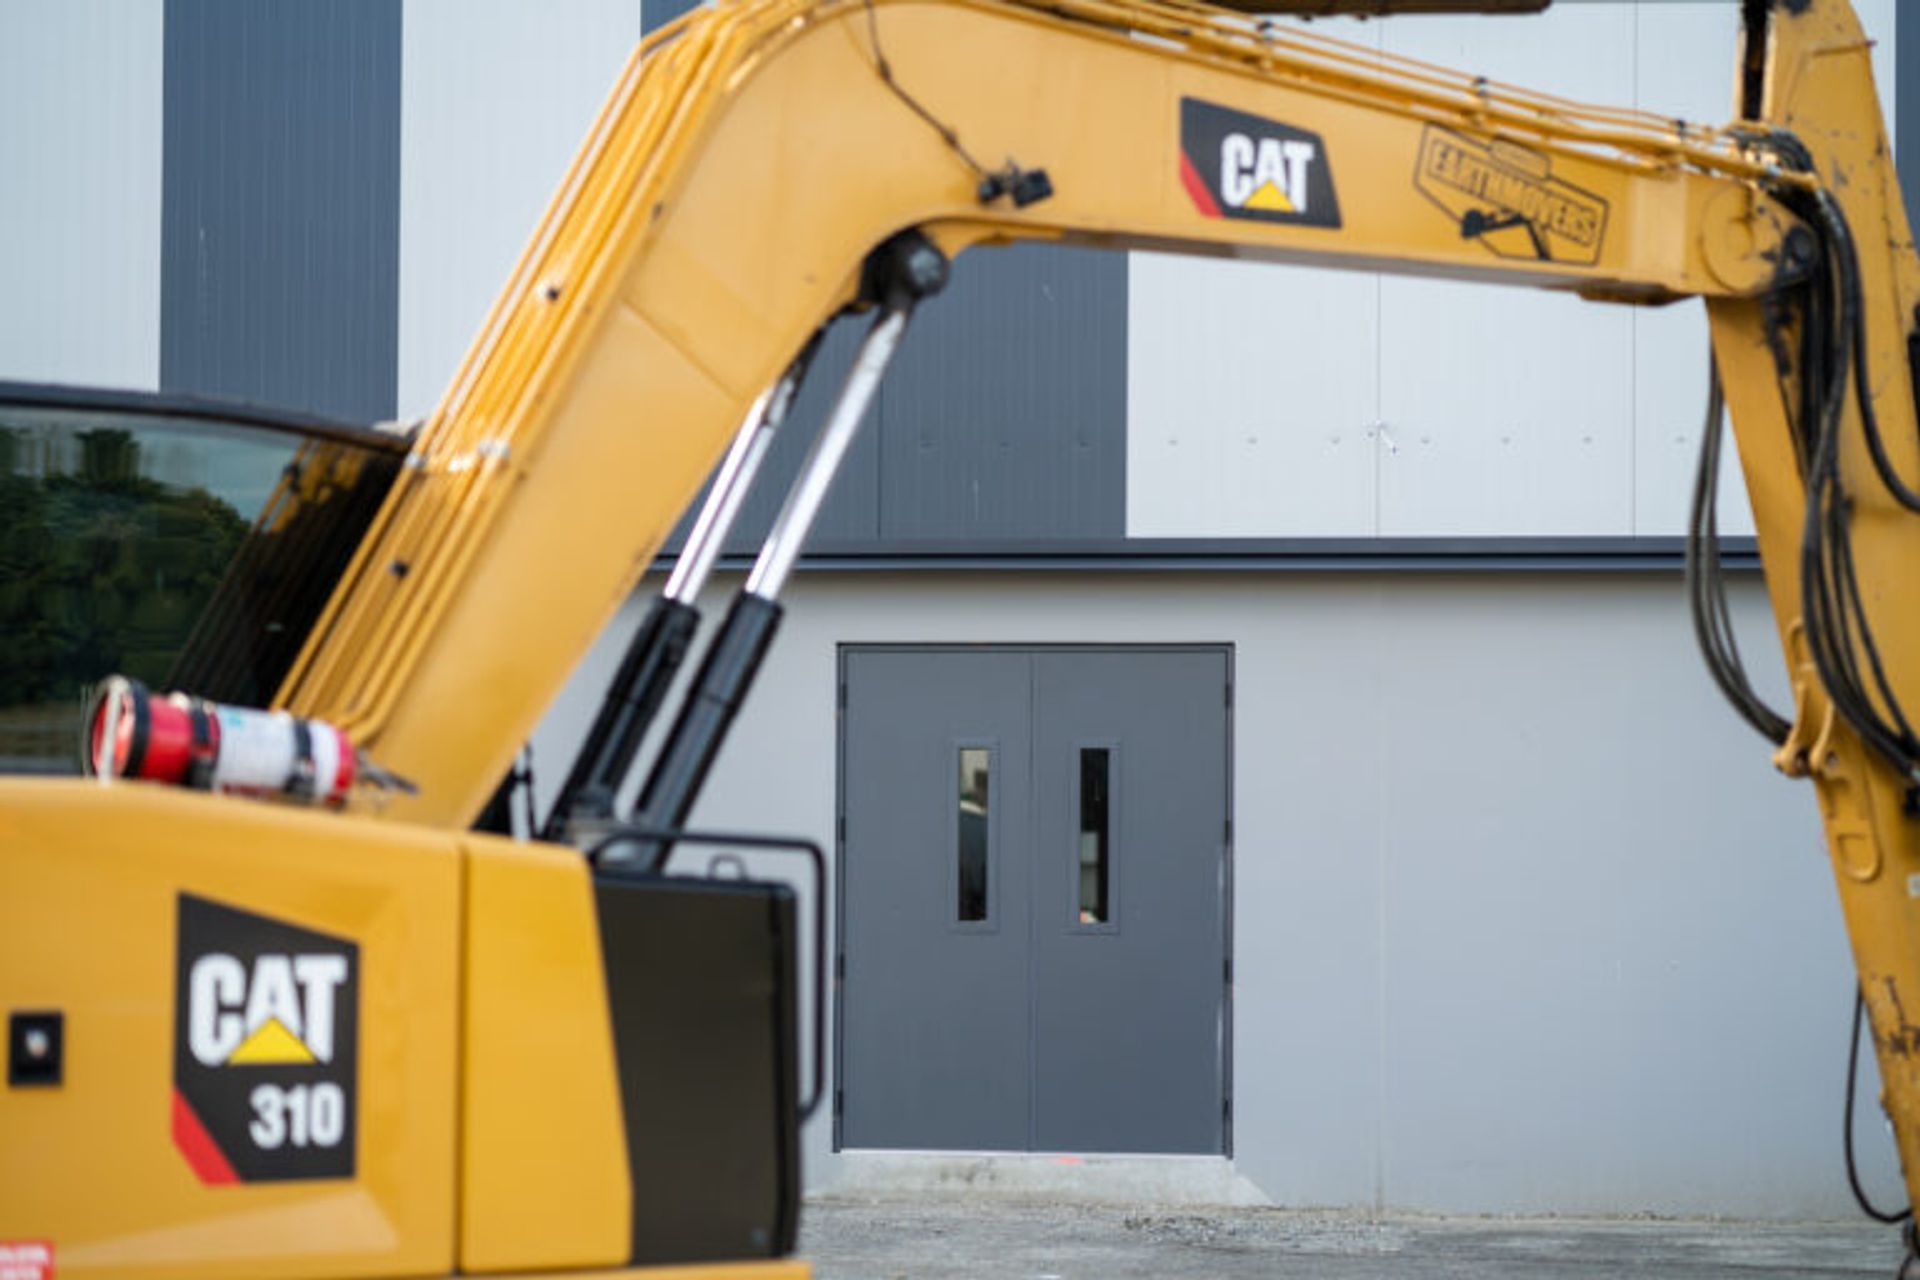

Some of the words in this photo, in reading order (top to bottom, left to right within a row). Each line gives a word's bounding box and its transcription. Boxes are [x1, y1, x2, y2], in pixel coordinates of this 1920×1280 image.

[1220, 132, 1315, 214] CAT
[1428, 138, 1598, 247] EARTHMOVERS
[190, 953, 348, 1066] CAT
[250, 1082, 345, 1149] 310
